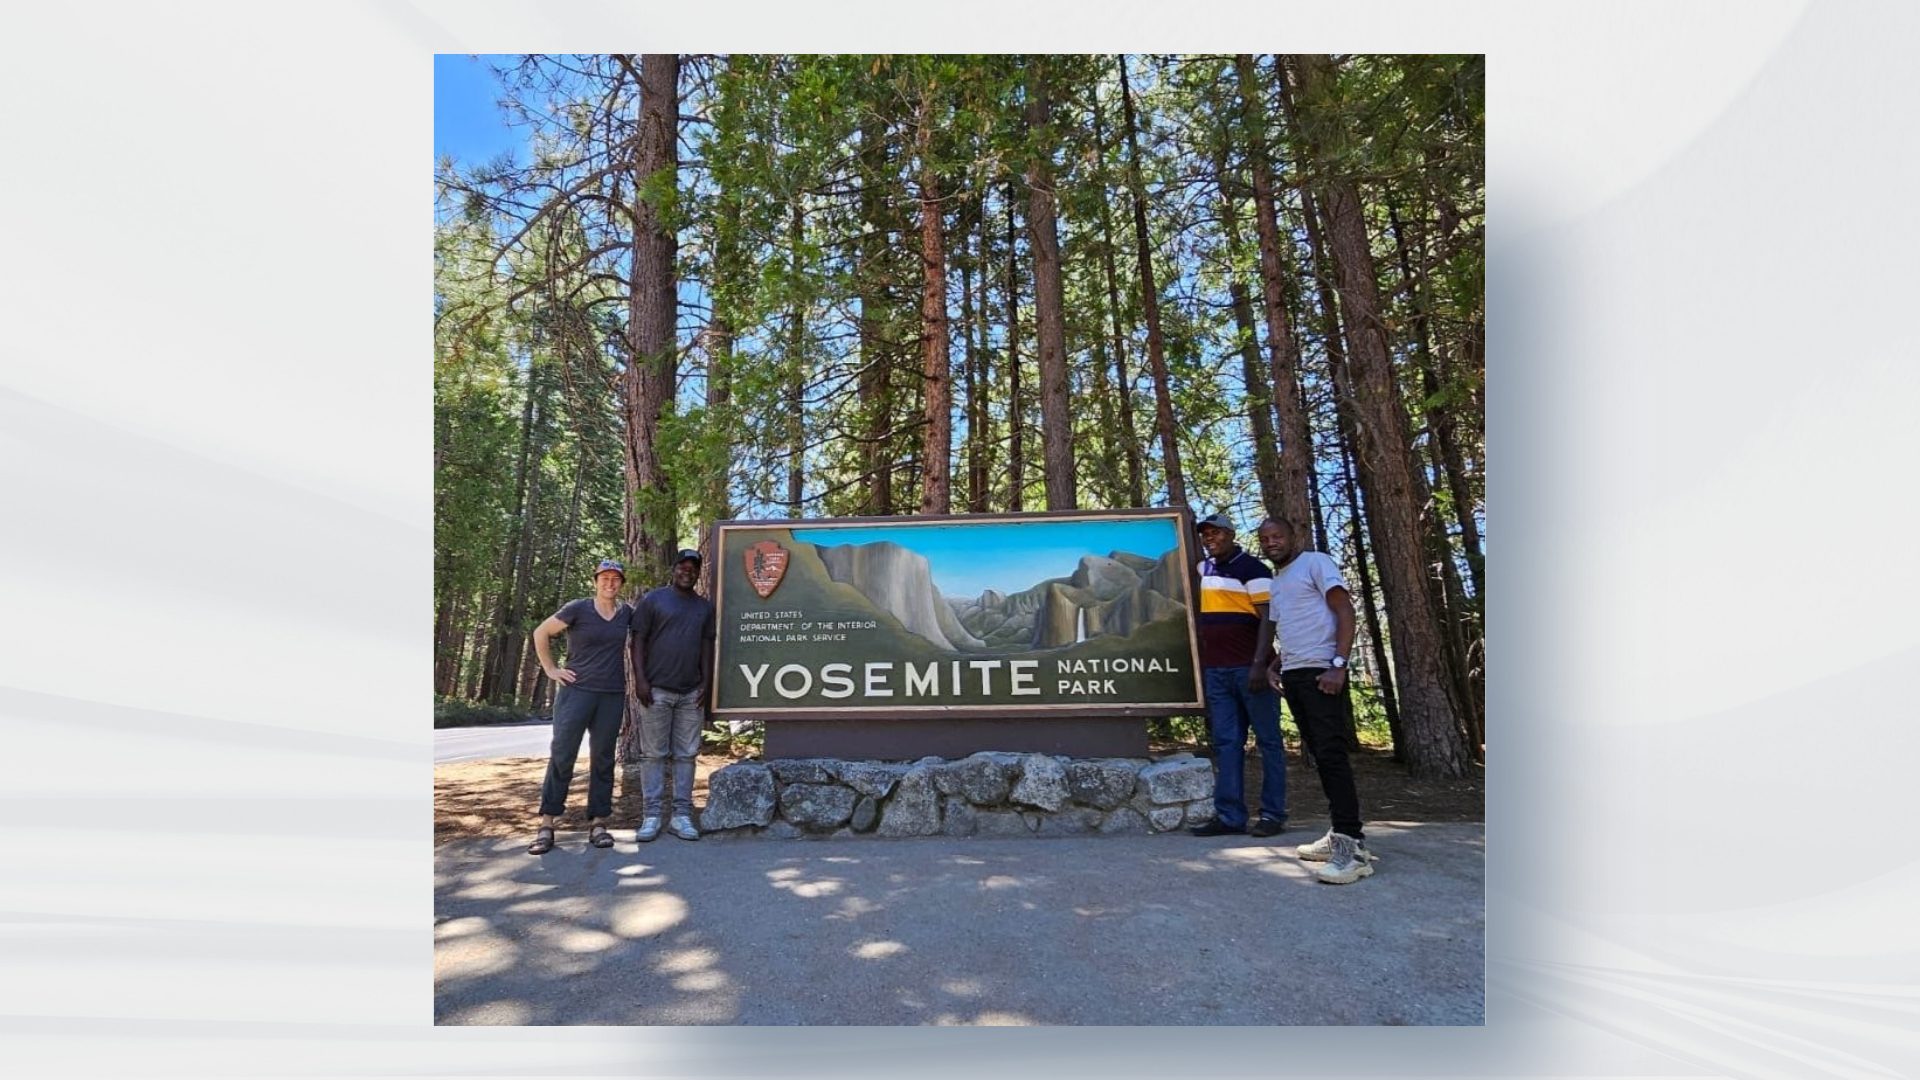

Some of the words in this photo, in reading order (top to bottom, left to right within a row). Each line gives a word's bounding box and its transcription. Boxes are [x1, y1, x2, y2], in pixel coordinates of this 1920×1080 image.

[741, 611, 770, 619] UNITED
[740, 623, 794, 631] DEPARTMENT
[818, 622, 833, 630] THE
[837, 621, 876, 629] INTERIOR
[740, 634, 782, 642] NATIONAL
[812, 633, 847, 641] SERVICE
[1057, 657, 1179, 675] NATIONAL
[739, 659, 1041, 699] YOSEMITE
[1057, 679, 1118, 696] PARK
